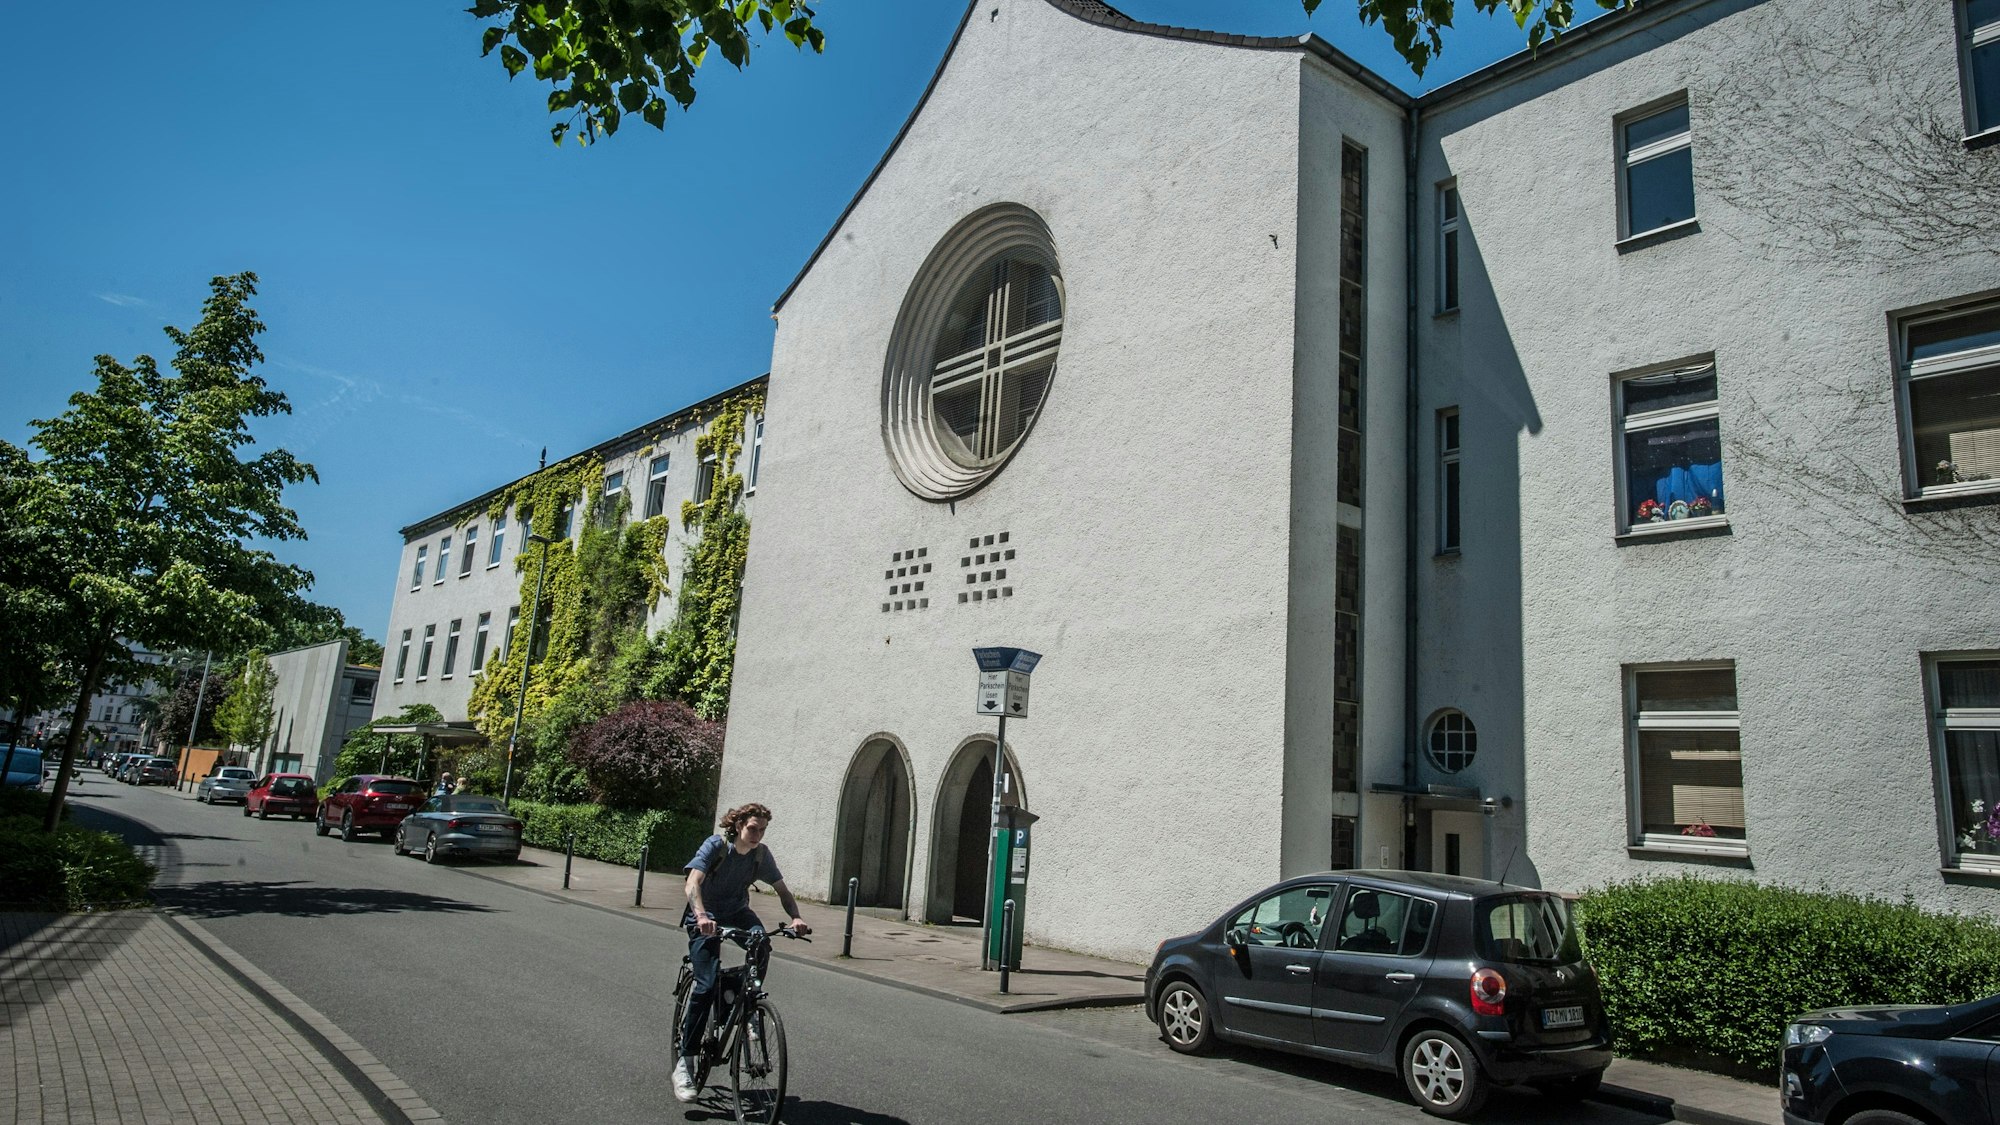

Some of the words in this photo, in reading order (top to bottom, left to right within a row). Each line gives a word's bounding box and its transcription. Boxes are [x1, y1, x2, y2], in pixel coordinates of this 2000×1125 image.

[980, 682, 1004, 690] Parkschein
[985, 691, 998, 699] lösen
[1016, 830, 1024, 845] P
